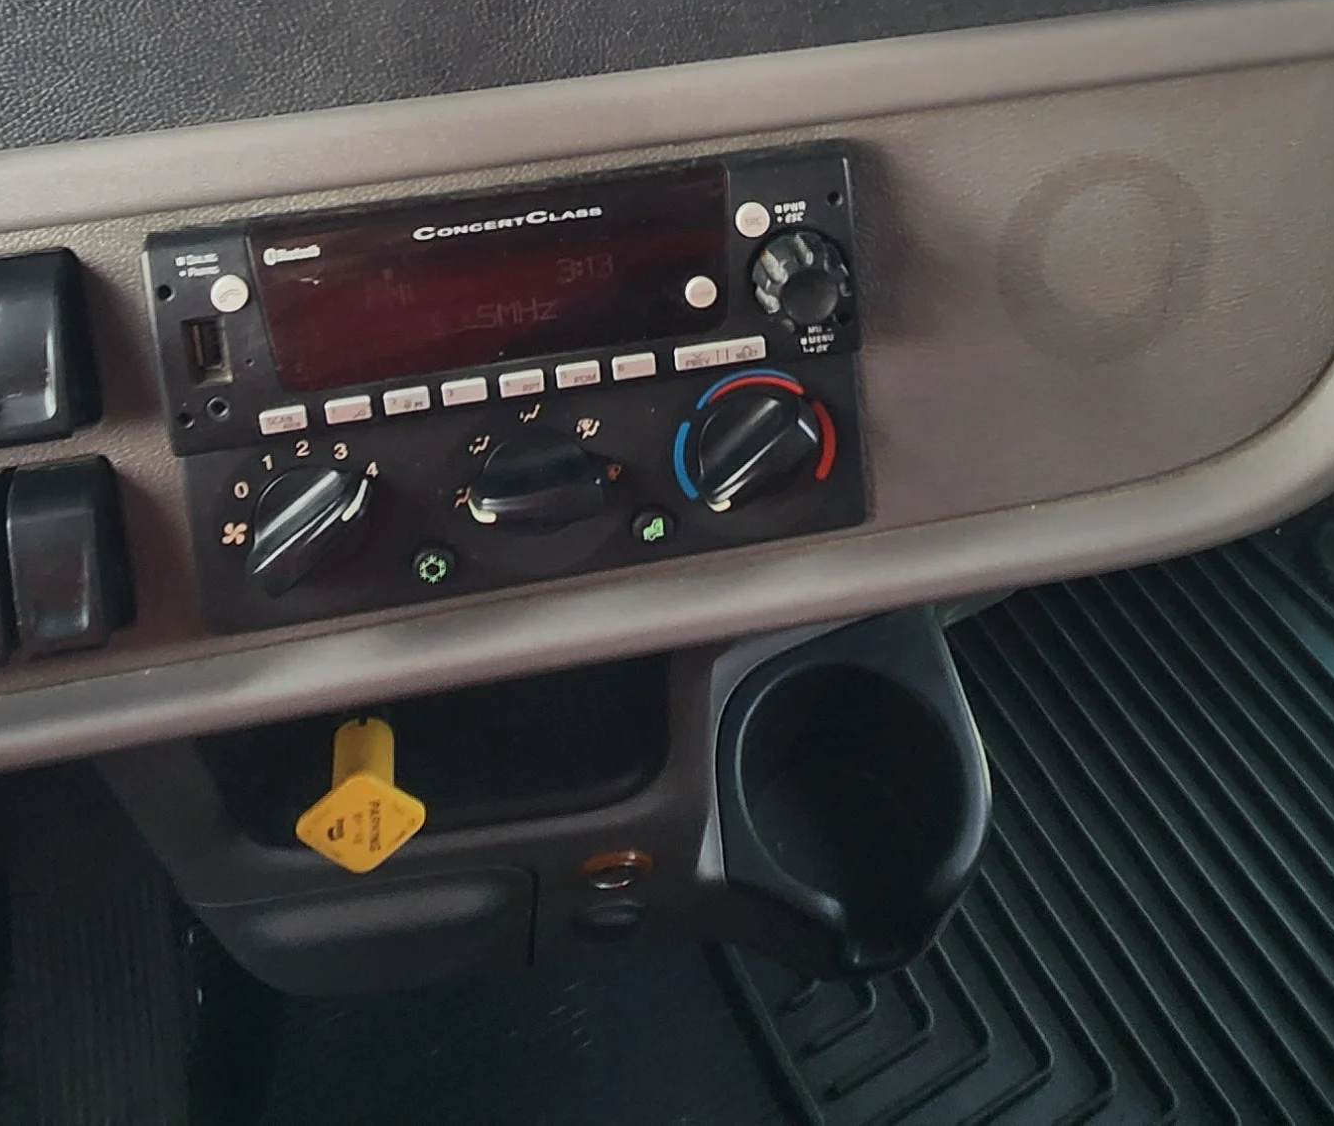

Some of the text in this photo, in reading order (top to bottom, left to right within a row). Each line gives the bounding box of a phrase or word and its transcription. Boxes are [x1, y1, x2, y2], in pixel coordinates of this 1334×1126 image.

[295, 440, 311, 457] 2
[333, 442, 349, 460] 3
[261, 454, 274, 471] 1
[365, 461, 379, 478] 4
[234, 481, 249, 499] 0
